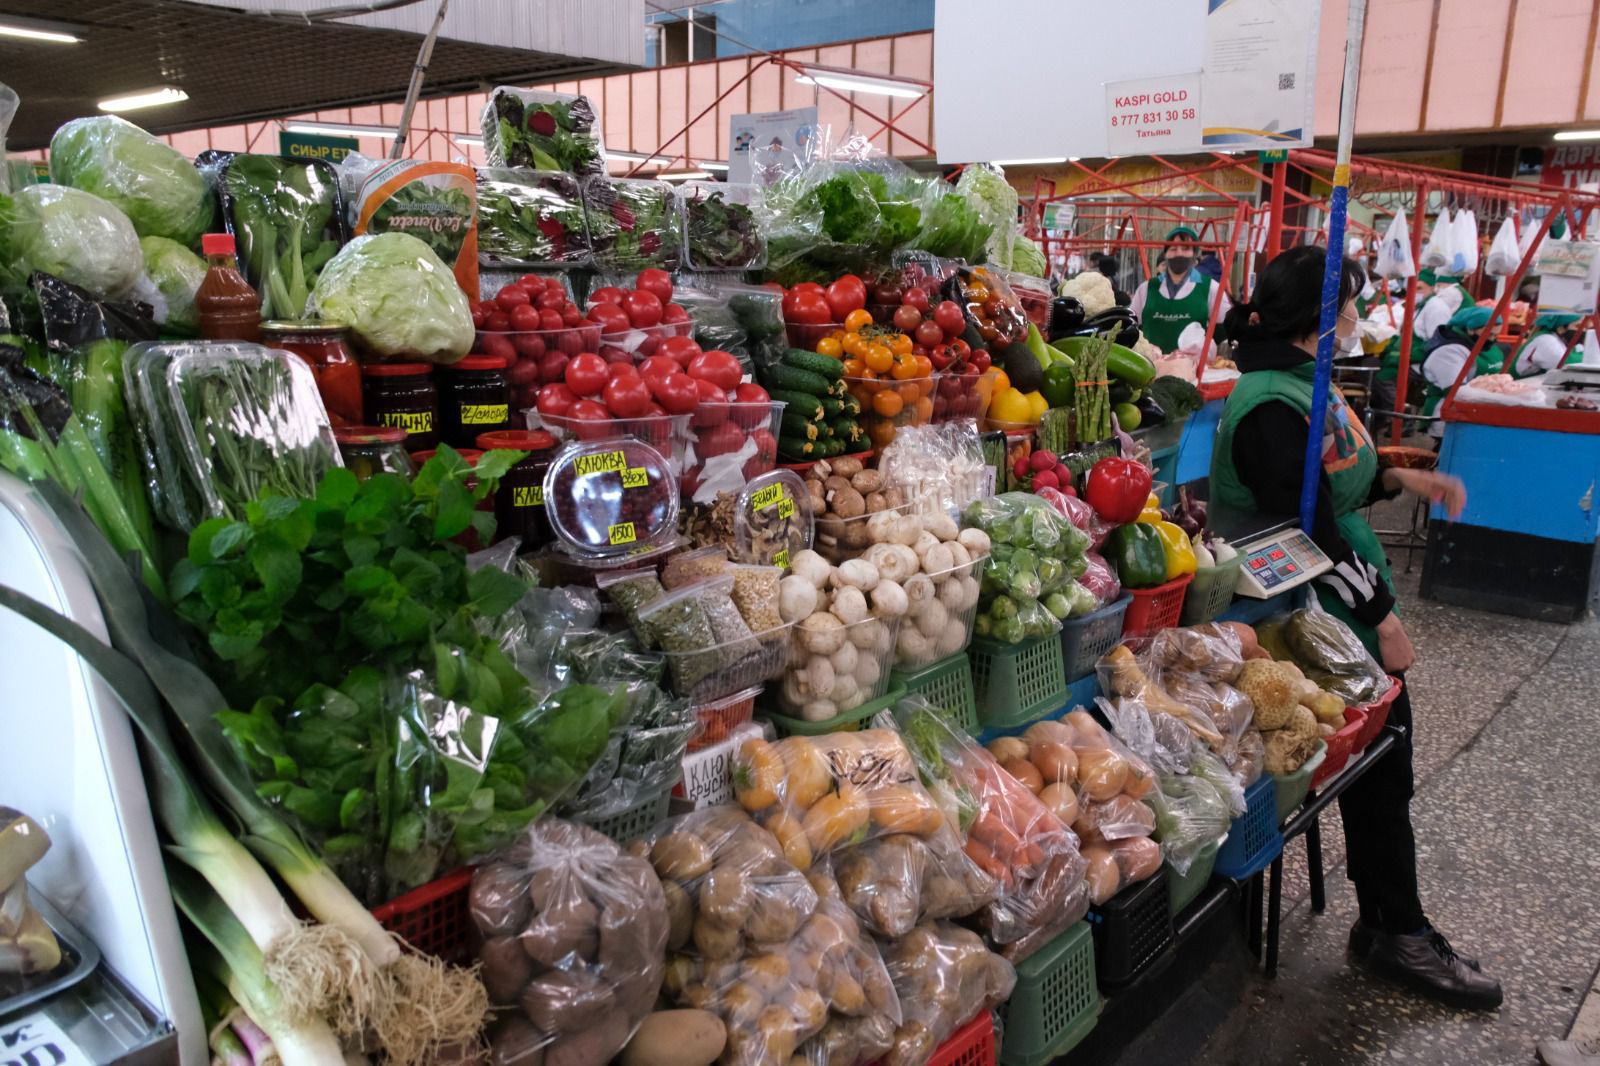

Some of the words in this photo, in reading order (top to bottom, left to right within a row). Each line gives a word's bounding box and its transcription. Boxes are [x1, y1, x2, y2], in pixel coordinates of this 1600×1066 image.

[1115, 94, 1150, 108] KASPI
[1153, 90, 1188, 104] GOLD
[1111, 116, 1118, 127] 8
[1121, 114, 1140, 126] 777
[1143, 112, 1161, 124] 831
[1166, 110, 1179, 122] 30
[1182, 108, 1196, 120] 58
[1136, 128, 1172, 138] Татьяна
[290, 143, 330, 158] СИЫР
[575, 451, 626, 475] КЛЮКВА
[610, 524, 634, 542] 1500
